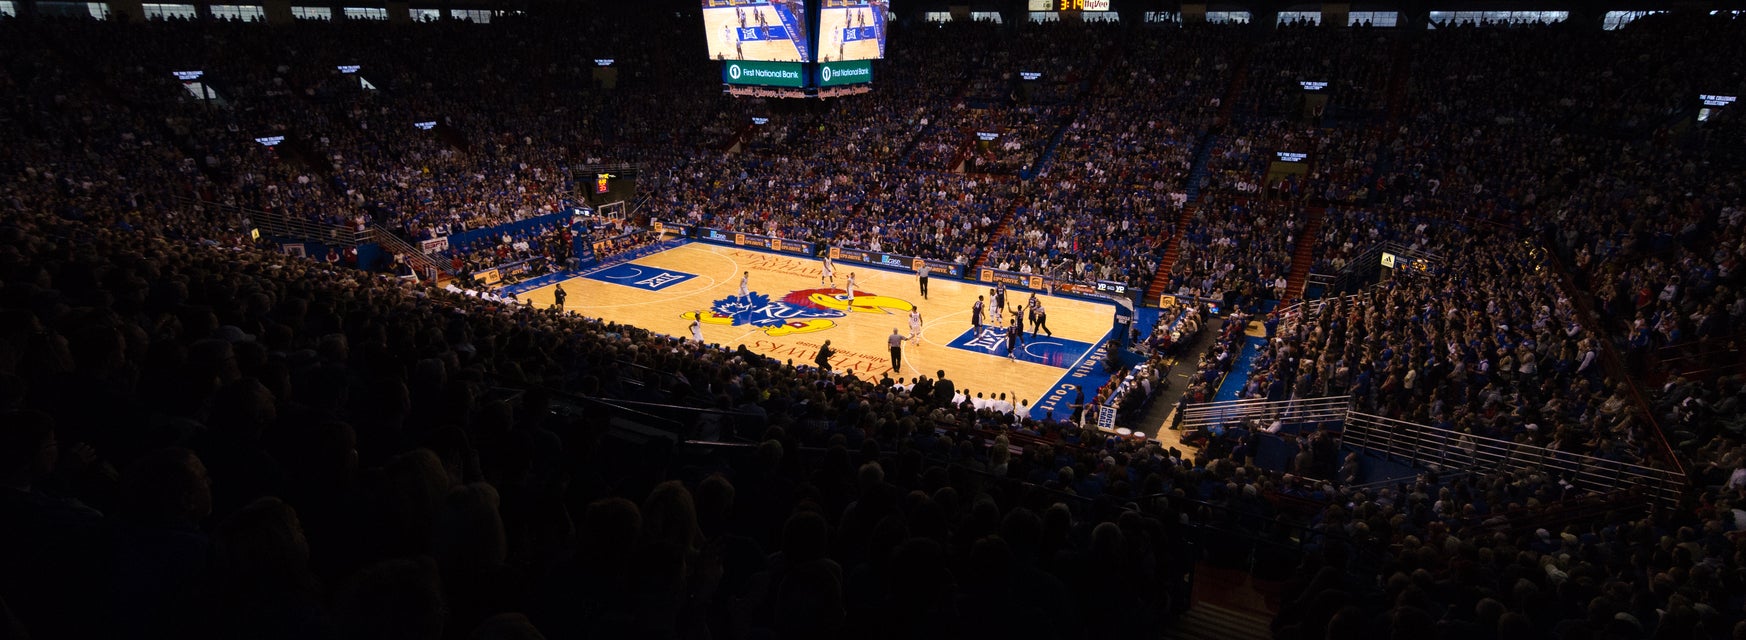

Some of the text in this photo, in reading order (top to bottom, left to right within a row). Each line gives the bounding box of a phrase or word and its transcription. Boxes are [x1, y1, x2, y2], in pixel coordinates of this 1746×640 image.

[743, 69, 755, 77] First
[755, 69, 782, 78] National
[782, 70, 799, 79] Bank
[832, 69, 841, 77] First
[841, 68, 858, 76] National
[858, 67, 869, 75] Bank
[1040, 384, 1076, 411] Court
